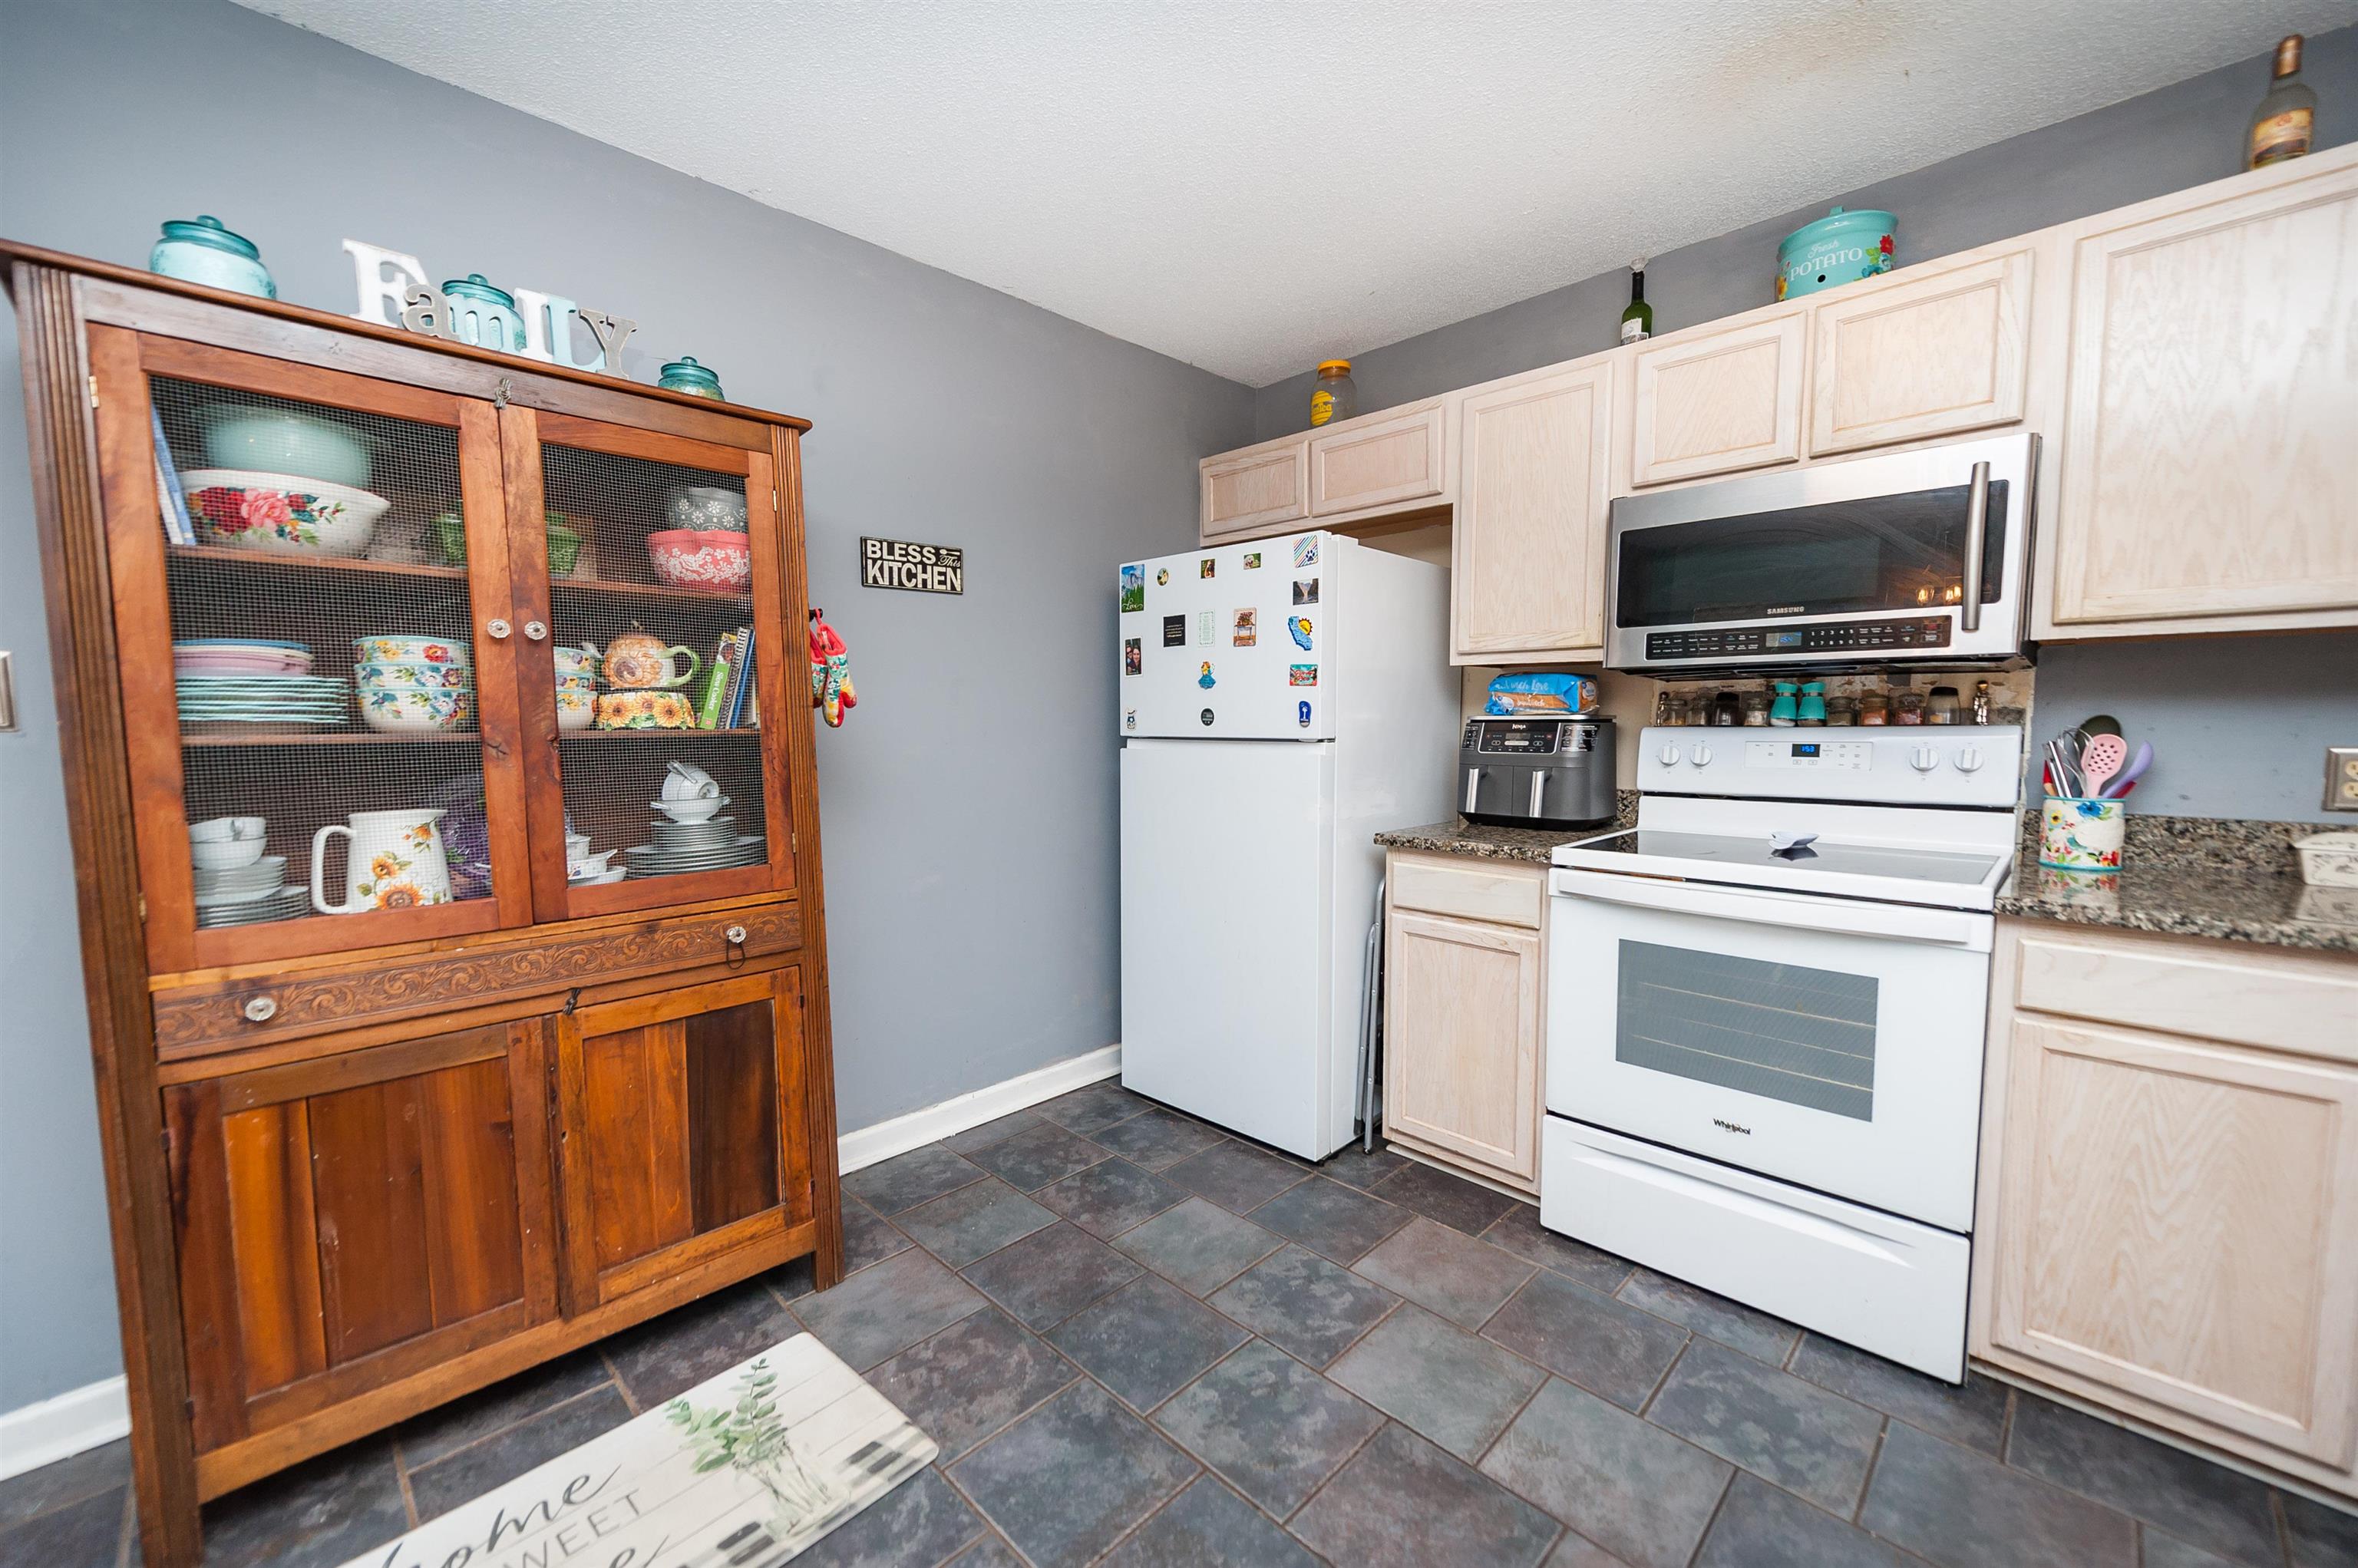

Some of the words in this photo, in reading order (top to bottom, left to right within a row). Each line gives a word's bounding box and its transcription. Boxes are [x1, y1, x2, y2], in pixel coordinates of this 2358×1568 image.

[1808, 239, 1839, 259] Fresh
[1791, 247, 1862, 281] POTATO
[867, 540, 936, 564] BLESS
[937, 554, 961, 567] This
[867, 559, 961, 591] KITCHEN
[714, 671, 724, 688] Slow
[708, 688, 720, 711] Cooker
[1712, 1117, 1751, 1135] Whirlpool
